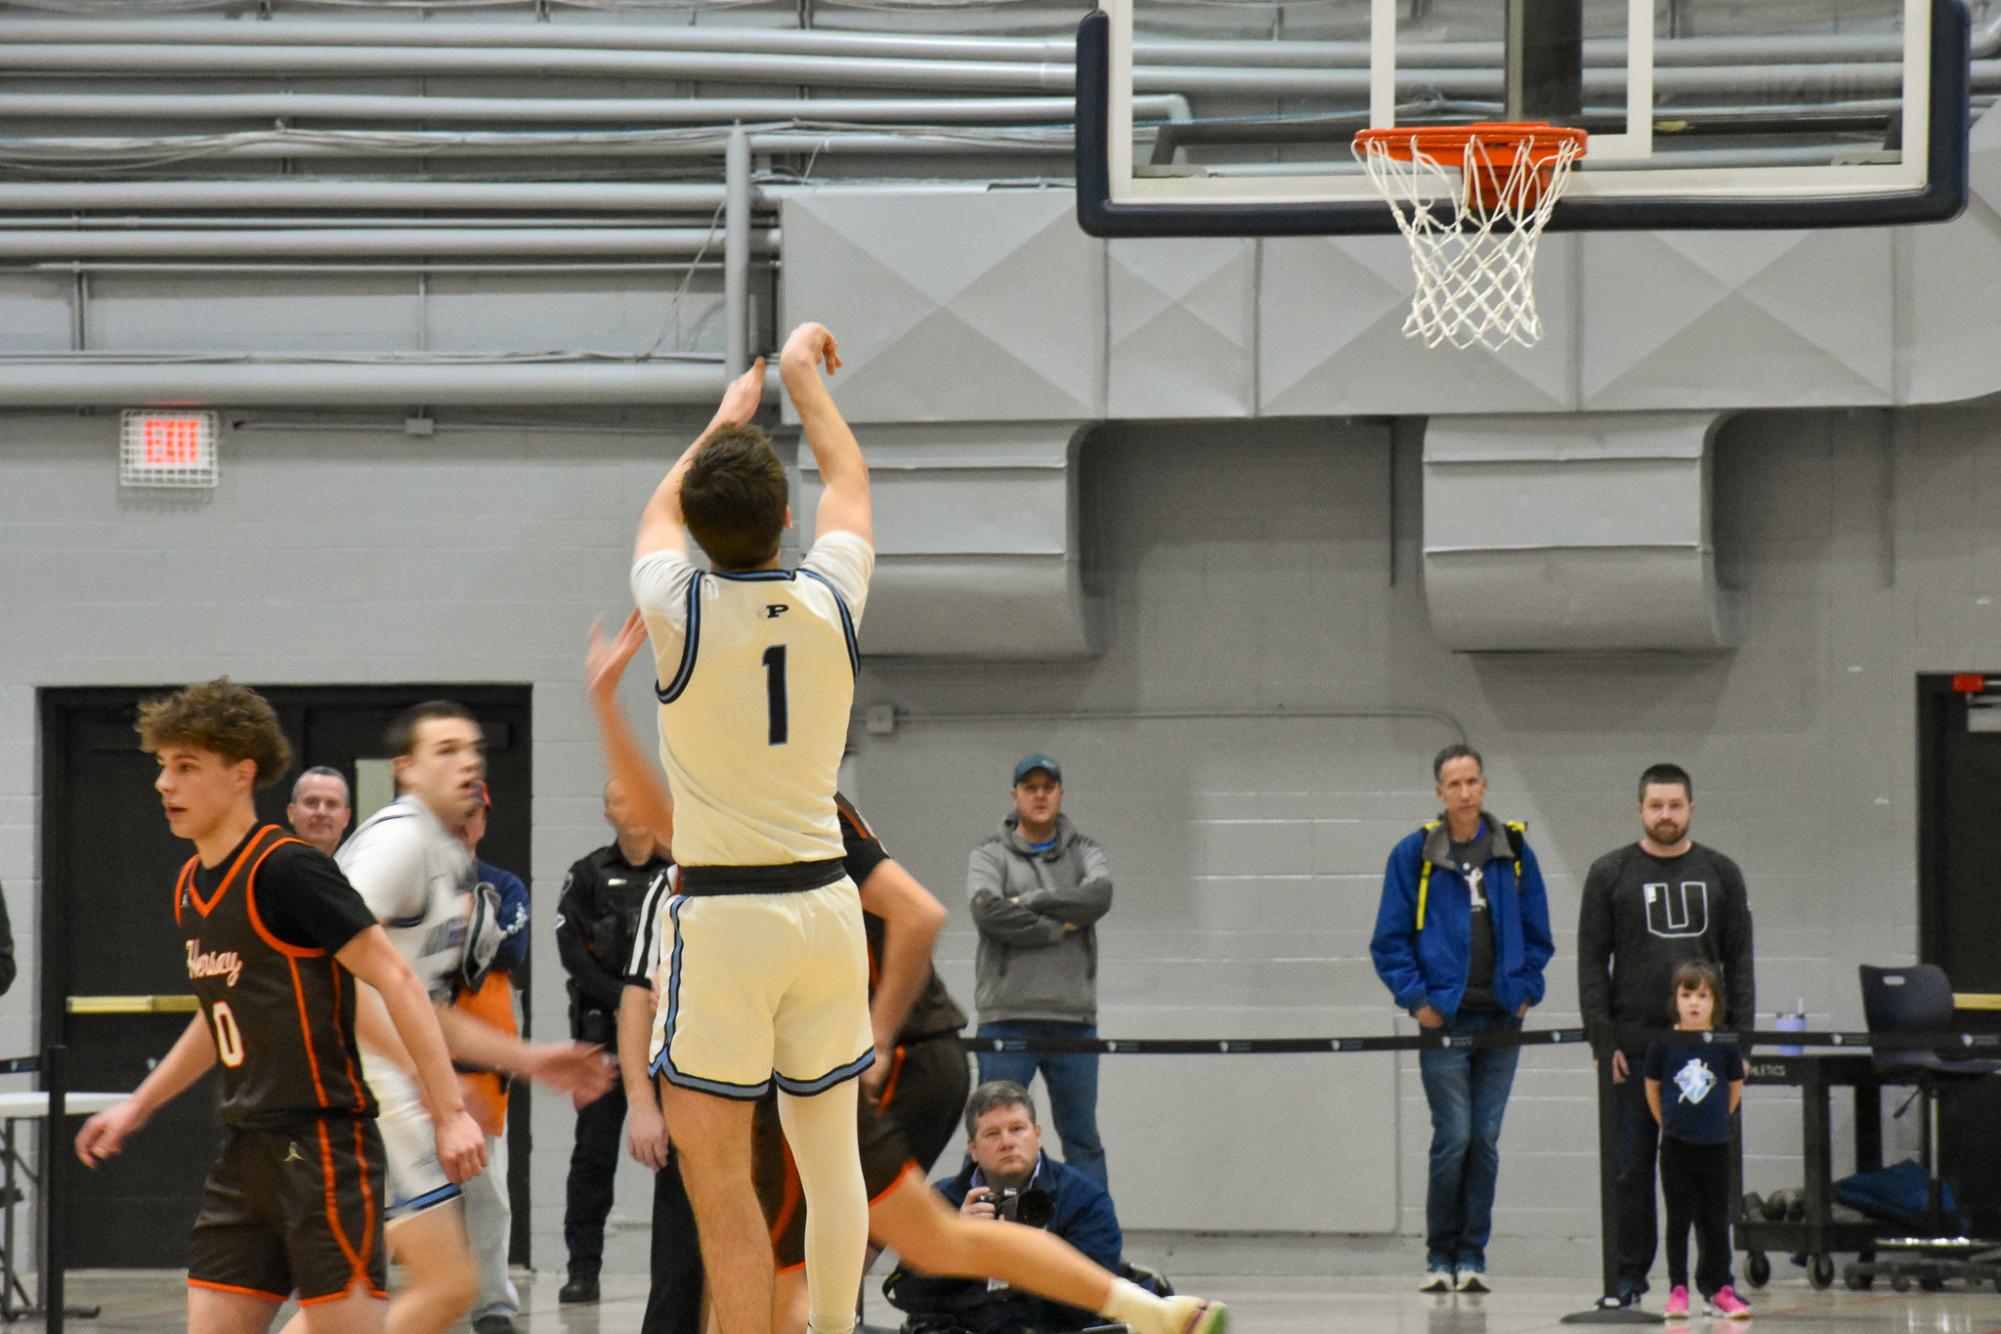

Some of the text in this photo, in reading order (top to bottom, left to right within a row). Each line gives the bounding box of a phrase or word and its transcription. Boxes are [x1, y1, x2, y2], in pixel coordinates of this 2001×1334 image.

[144, 419, 200, 464] EXIT
[766, 604, 789, 618] P
[762, 645, 787, 745] 1
[1643, 881, 1708, 938] U
[212, 1000, 245, 1068] 0
